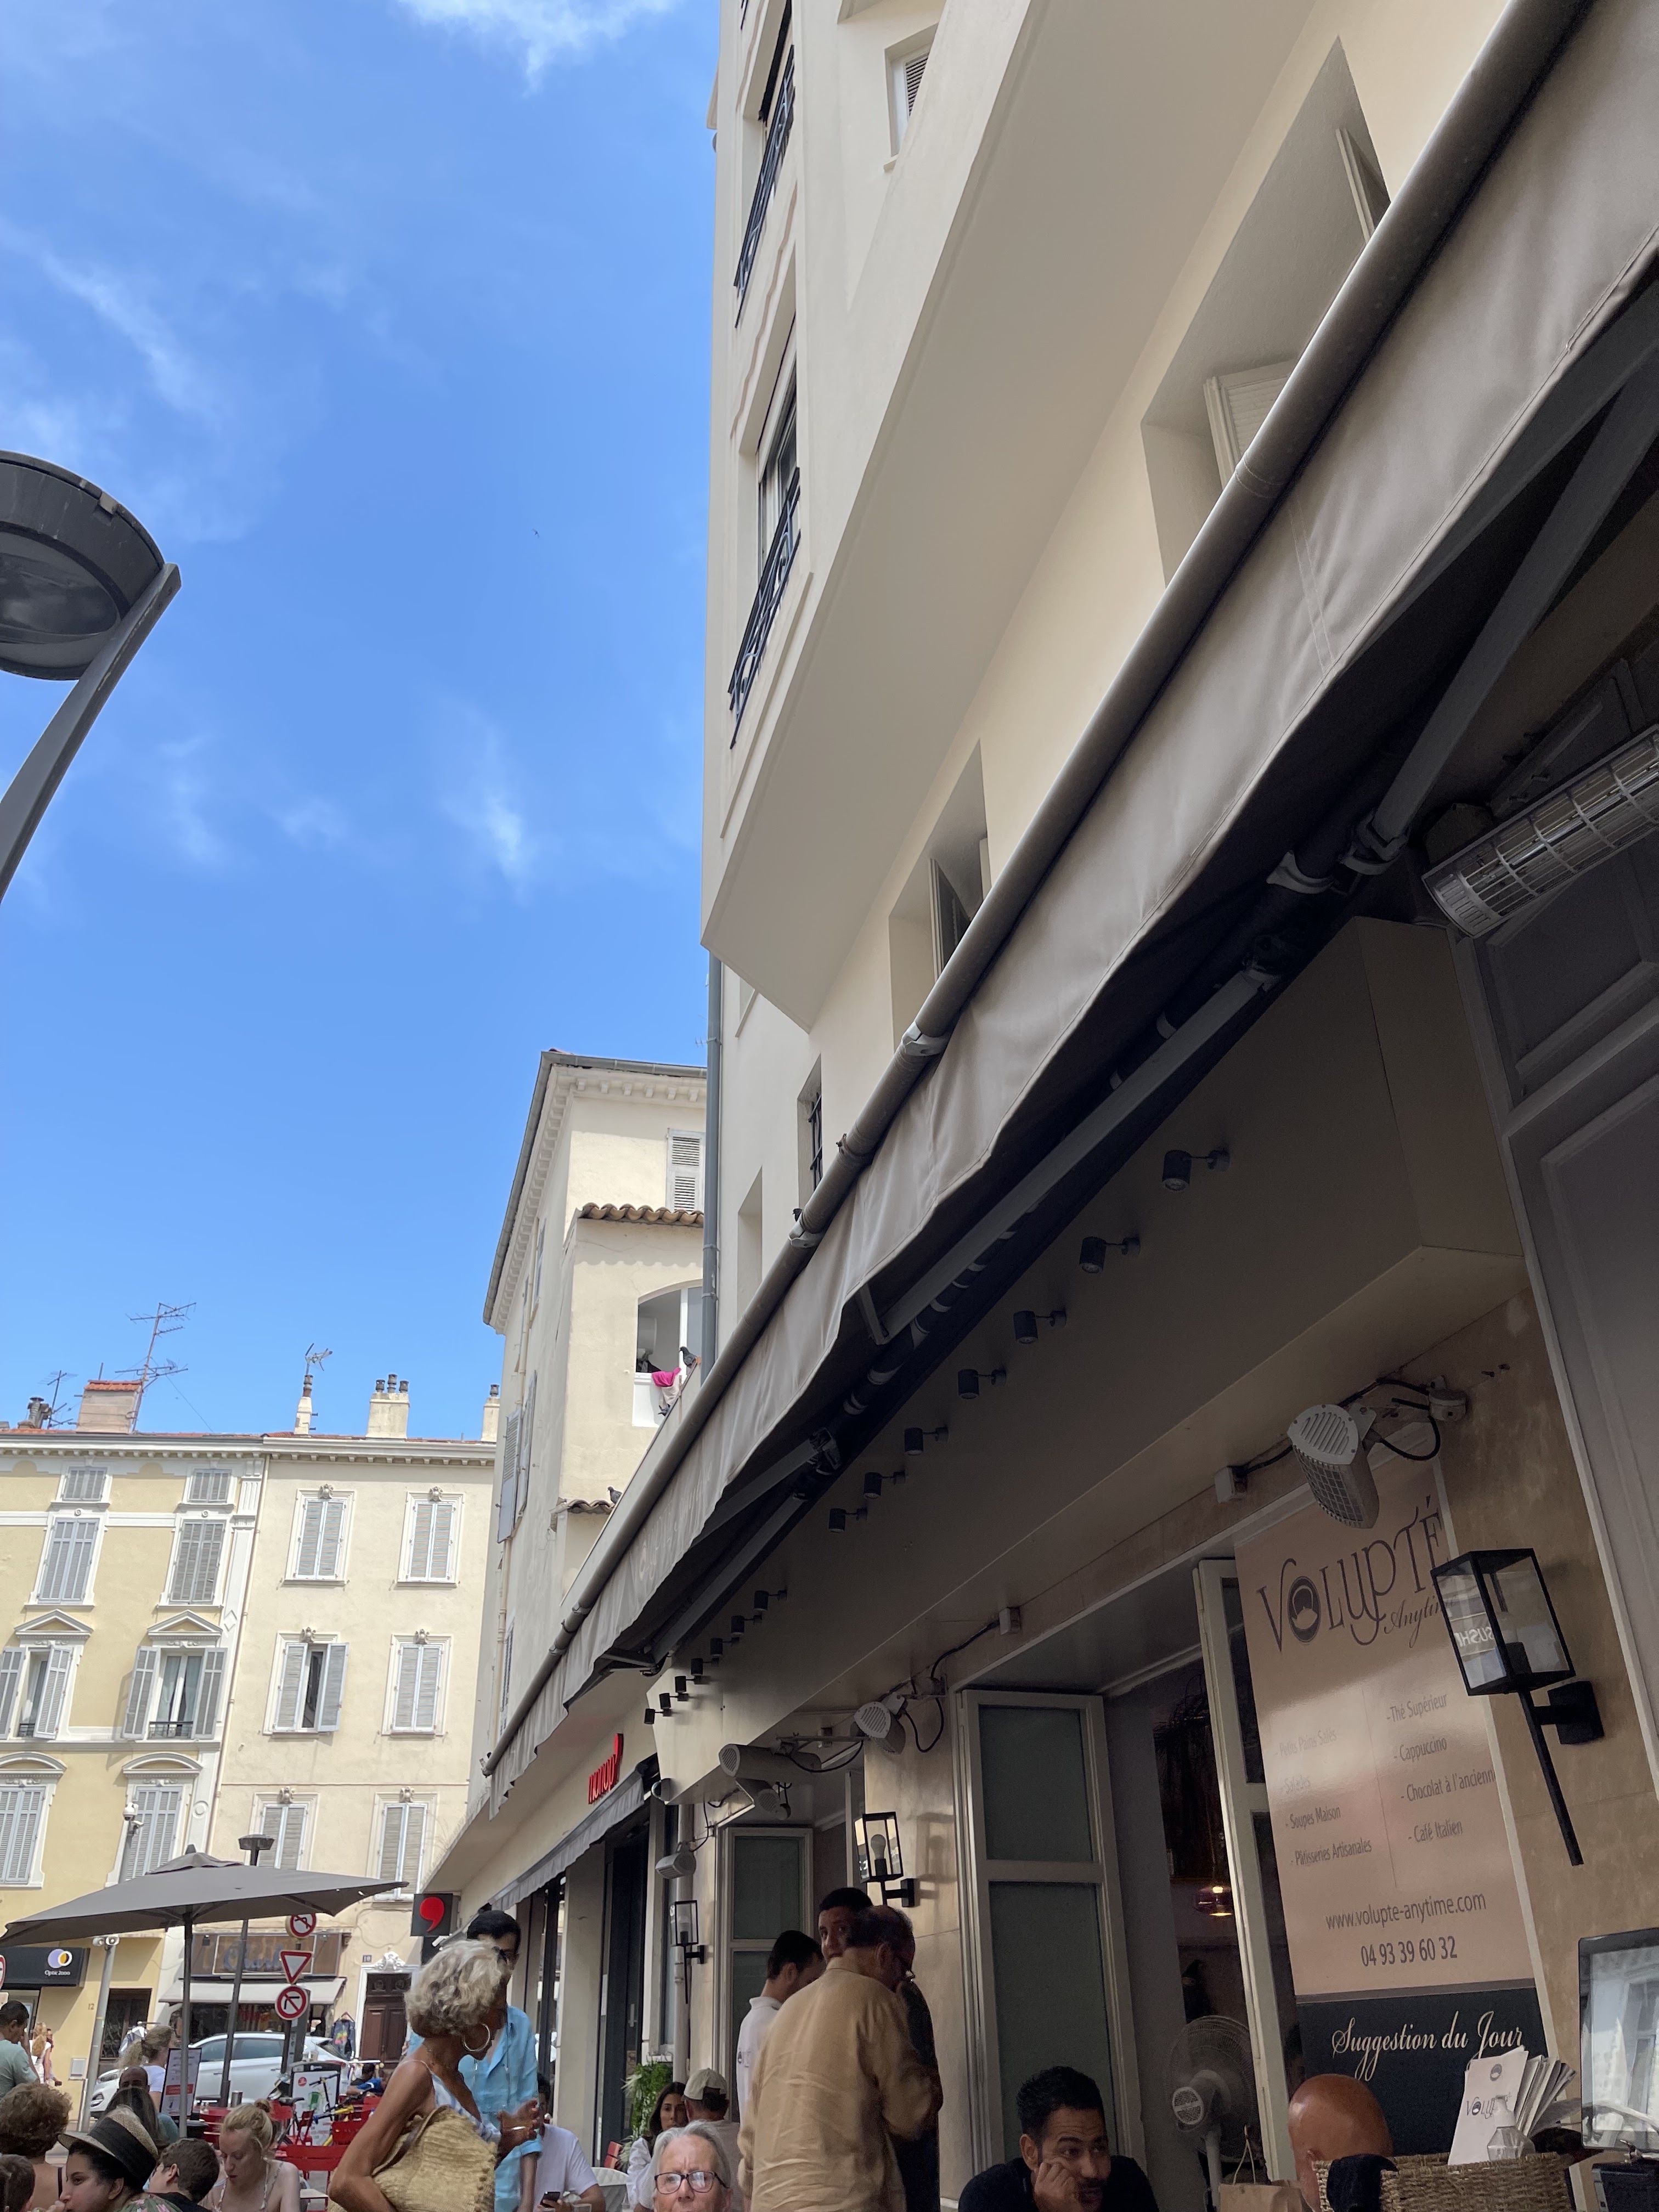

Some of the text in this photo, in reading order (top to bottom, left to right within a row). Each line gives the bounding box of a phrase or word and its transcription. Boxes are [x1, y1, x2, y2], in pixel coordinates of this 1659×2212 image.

[1384, 1595, 1442, 1649] Anyti
[1407, 1694, 1448, 1718] Supérieur
[1400, 1736, 1447, 1762] Cappuccino
[1407, 1768, 1496, 1802] Chocolat à l'ancienn
[1290, 1806, 1341, 1830] Soupes Maison
[1414, 1819, 1463, 1843] Café Italien
[1295, 1837, 1372, 1866] Pâtisseries Artisanales
[1325, 1893, 1487, 1929] www.volupte-anytime.com
[1361, 1936, 1457, 1967] 04 93 39 60 32
[1331, 2010, 1522, 2081] Suggestion du Jour
